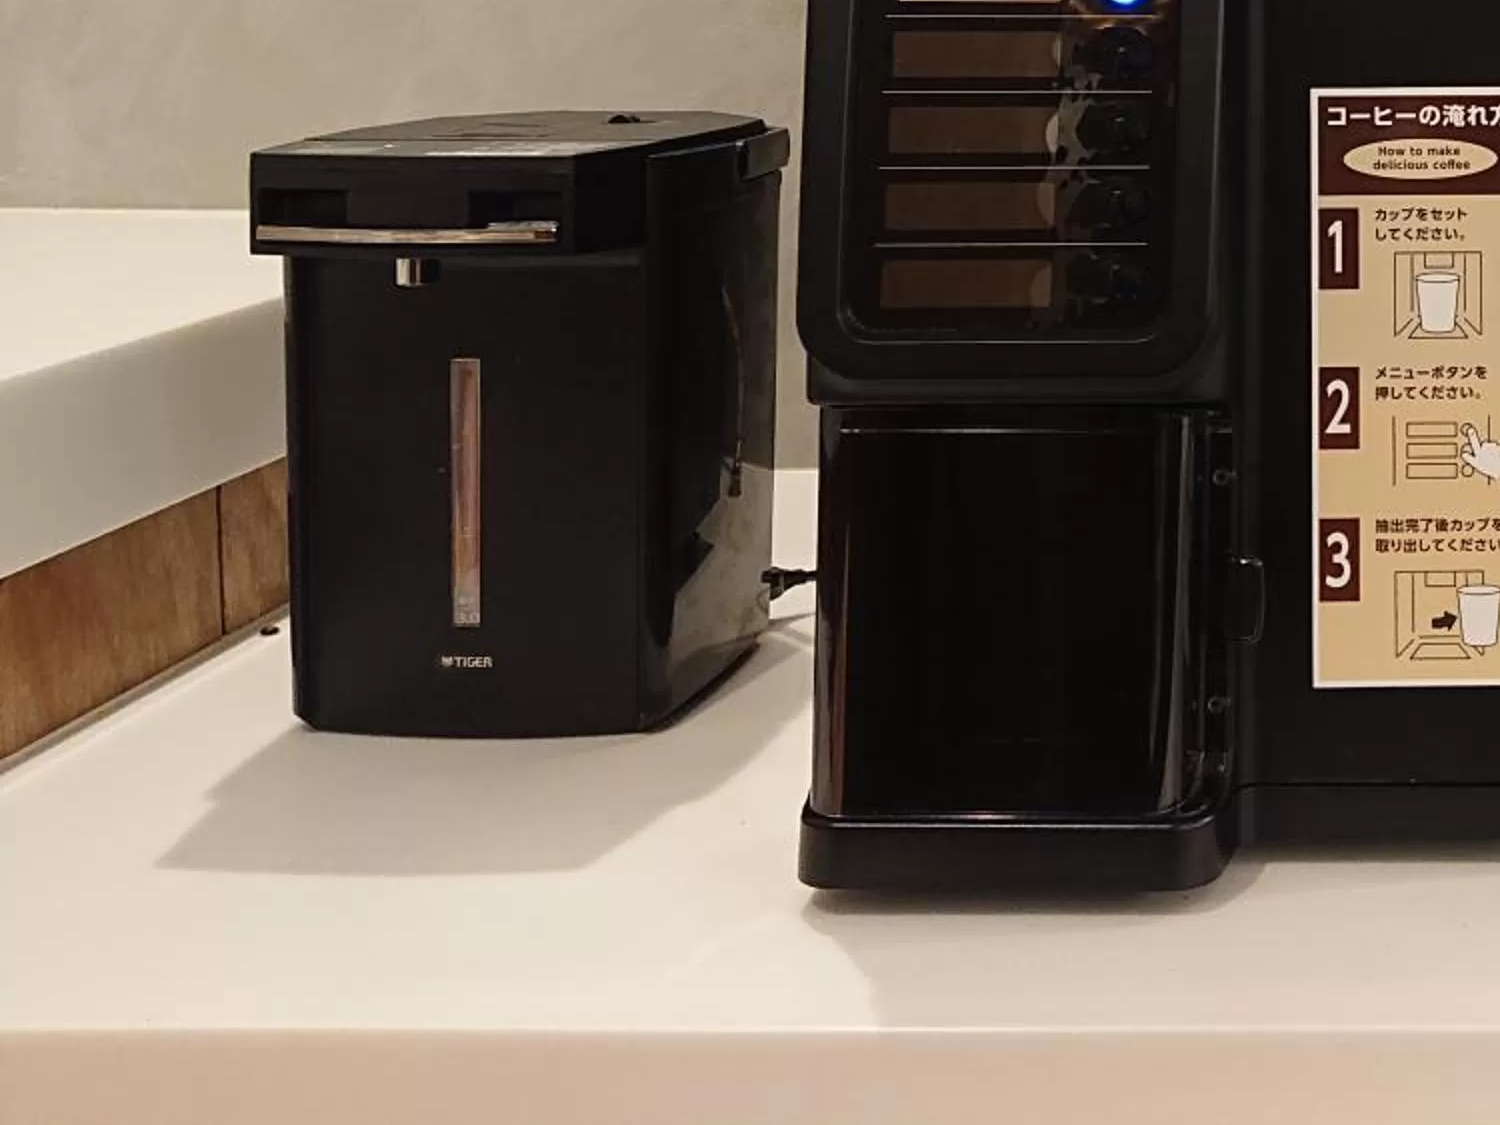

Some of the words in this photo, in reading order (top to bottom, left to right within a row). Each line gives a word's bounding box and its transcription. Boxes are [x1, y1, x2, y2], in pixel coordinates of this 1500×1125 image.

[1377, 146, 1405, 156] How
[1409, 146, 1423, 156] to
[1427, 146, 1461, 156] make
[1372, 159, 1429, 170] delicious
[1433, 159, 1471, 170] coffee
[1374, 208, 1468, 222] カップをセット
[1374, 227, 1467, 242] してください。
[1326, 219, 1344, 274] 1
[1374, 365, 1488, 380] メニューボタンを
[1374, 386, 1482, 401] 押してください。
[1325, 378, 1352, 435] 2
[1325, 531, 1351, 589] 3
[453, 656, 493, 668] TIGER
